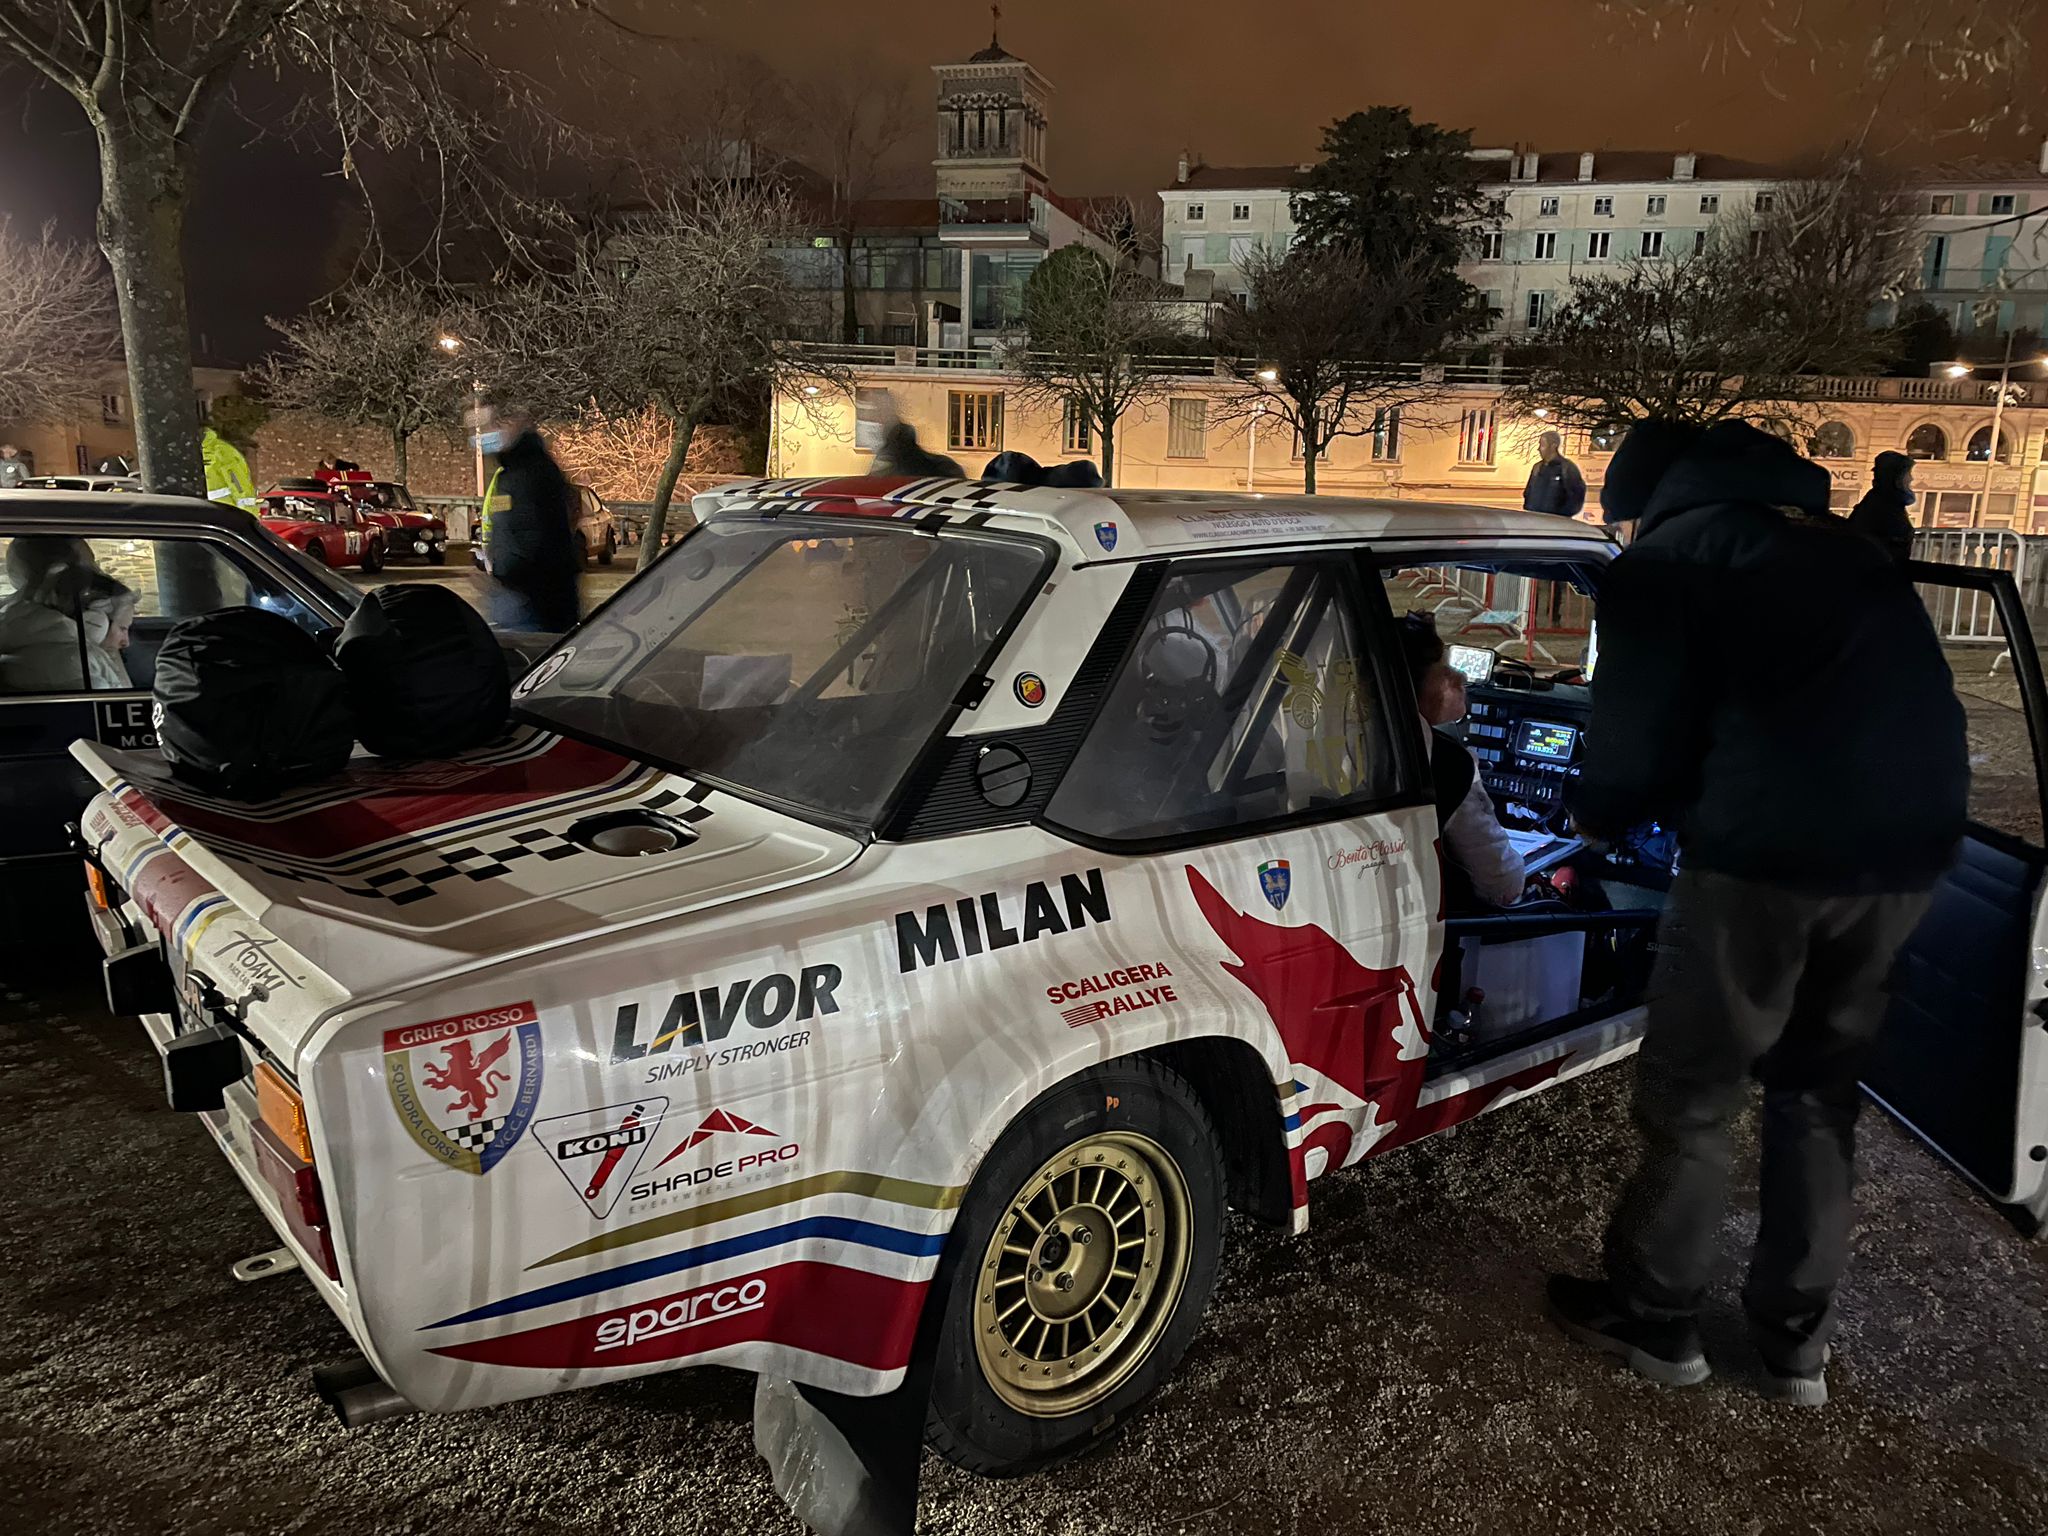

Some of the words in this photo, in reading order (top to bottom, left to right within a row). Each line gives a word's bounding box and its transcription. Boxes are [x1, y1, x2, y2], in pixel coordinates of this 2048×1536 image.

[1830, 470, 1859, 481] NCE
[1968, 474, 1986, 482] VENT
[104, 703, 146, 728] LE
[895, 867, 1112, 974] MILAN
[1047, 961, 1174, 1005] SCALIGERA
[1095, 985, 1178, 1020] RALLYE
[400, 1021, 459, 1046] GRIFO
[463, 1007, 524, 1032] ROSSO
[609, 963, 843, 1066] LAVOR
[521, 1033, 537, 1105] BERNARDI
[645, 1051, 717, 1084] SIMPLY
[717, 1030, 811, 1066] STRONGER
[392, 1063, 424, 1130] SQUADRA
[420, 1128, 461, 1161] CORSE
[564, 1128, 643, 1157] KONI
[628, 1182, 735, 1215] EVERYWHERE
[745, 1171, 772, 1183] YOU
[630, 1161, 733, 1201] SHADE
[738, 1143, 800, 1173] PRO
[595, 1278, 767, 1347] sparco
